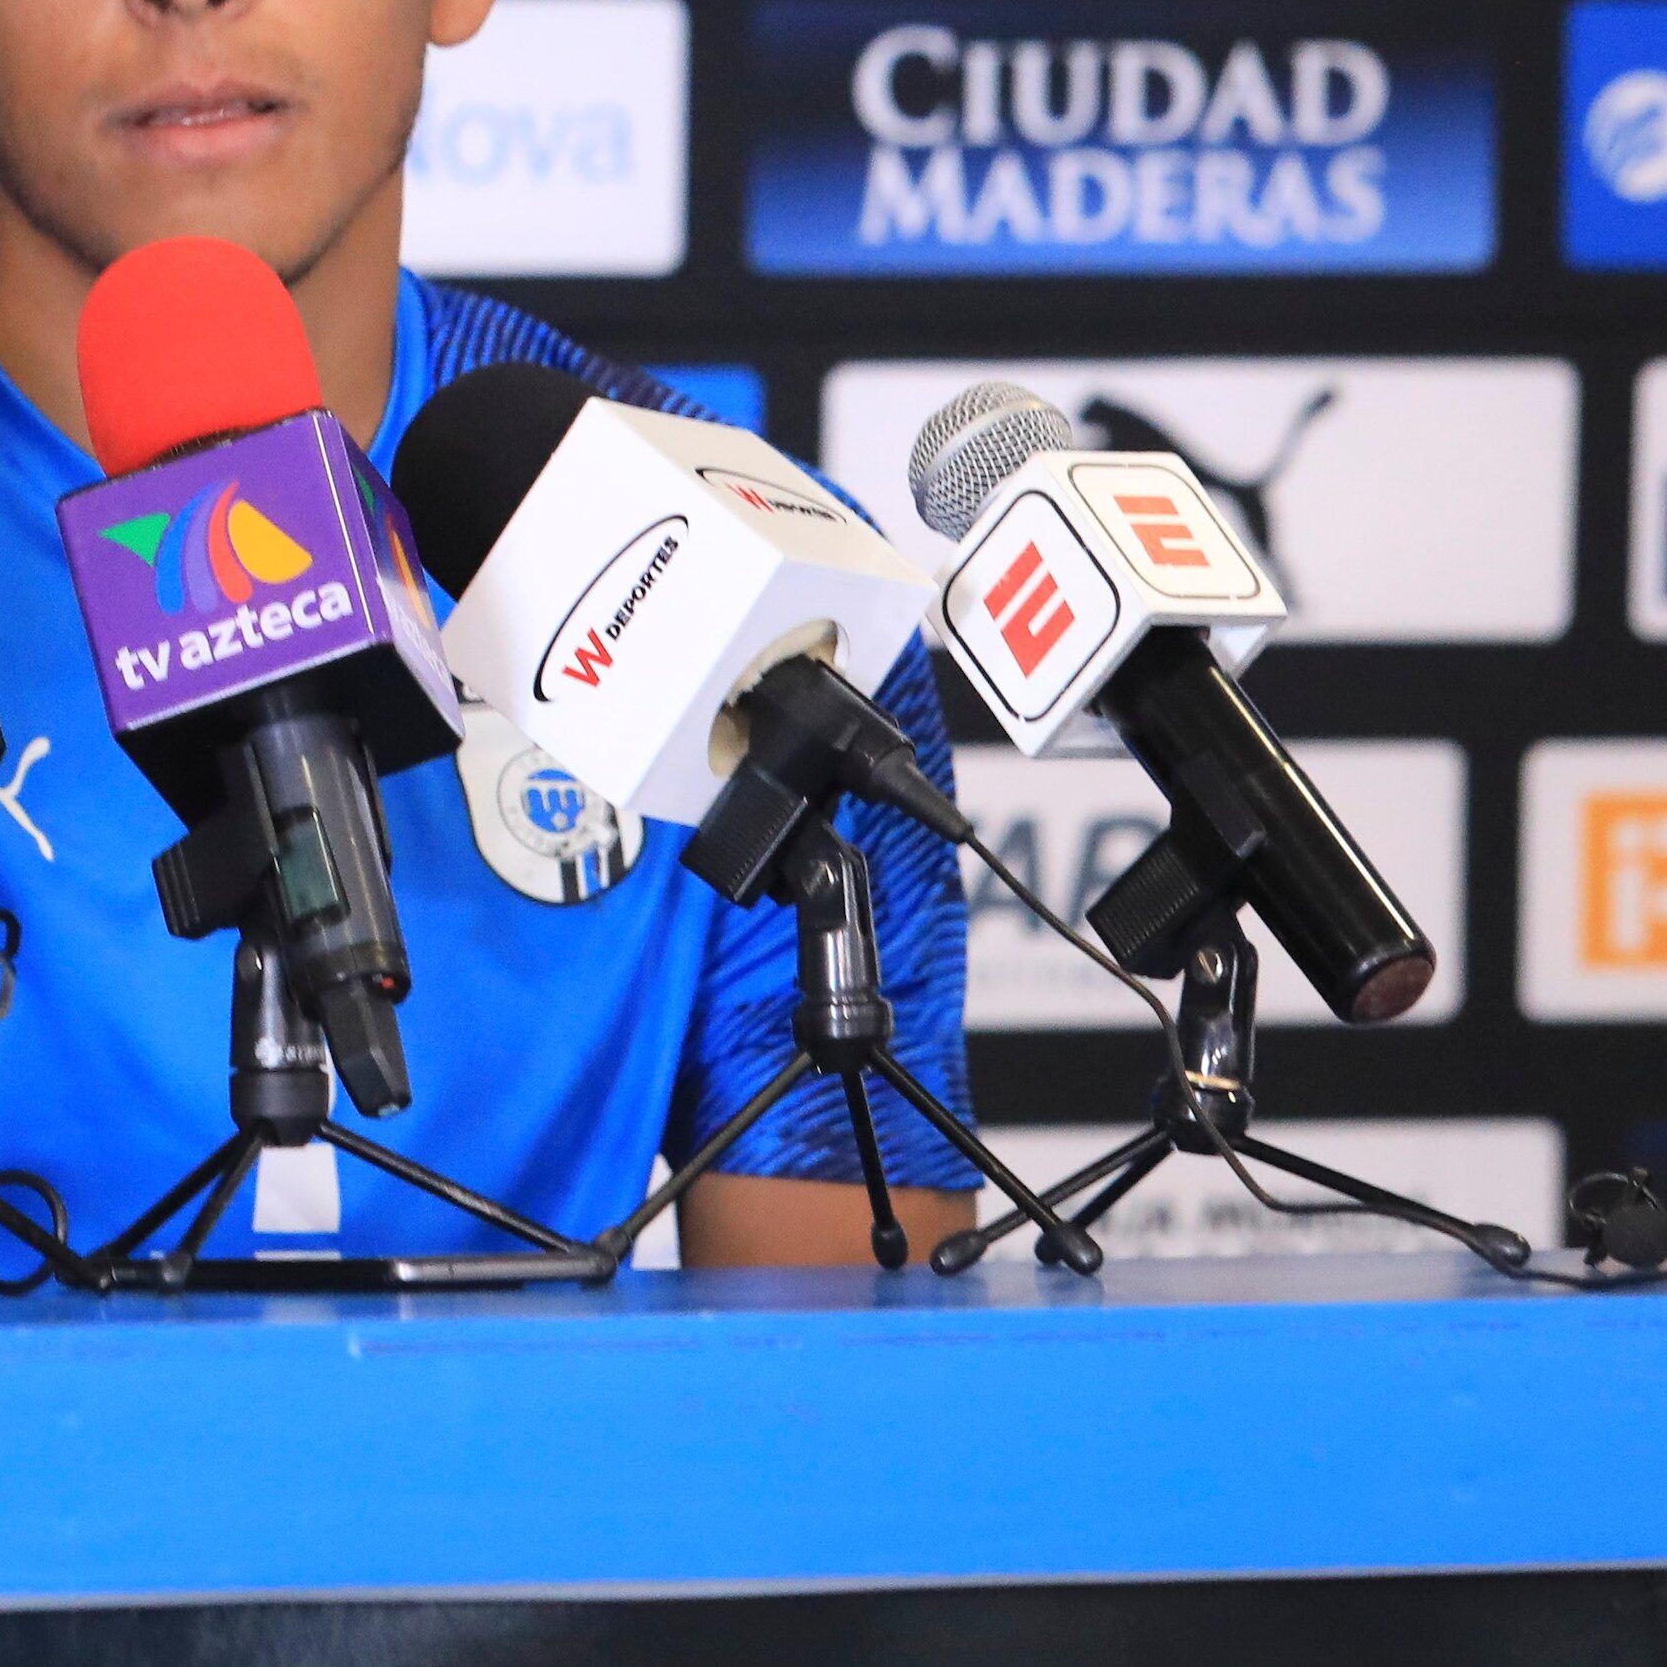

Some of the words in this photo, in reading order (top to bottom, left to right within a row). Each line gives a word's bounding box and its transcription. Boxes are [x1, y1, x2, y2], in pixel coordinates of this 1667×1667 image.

[852, 24, 1391, 148] CIUDAD
[858, 146, 1387, 248] MADERAS
[114, 639, 170, 691] tv
[179, 581, 354, 671] azteca
[562, 627, 614, 688] W
[604, 535, 679, 642] DEPORTES
